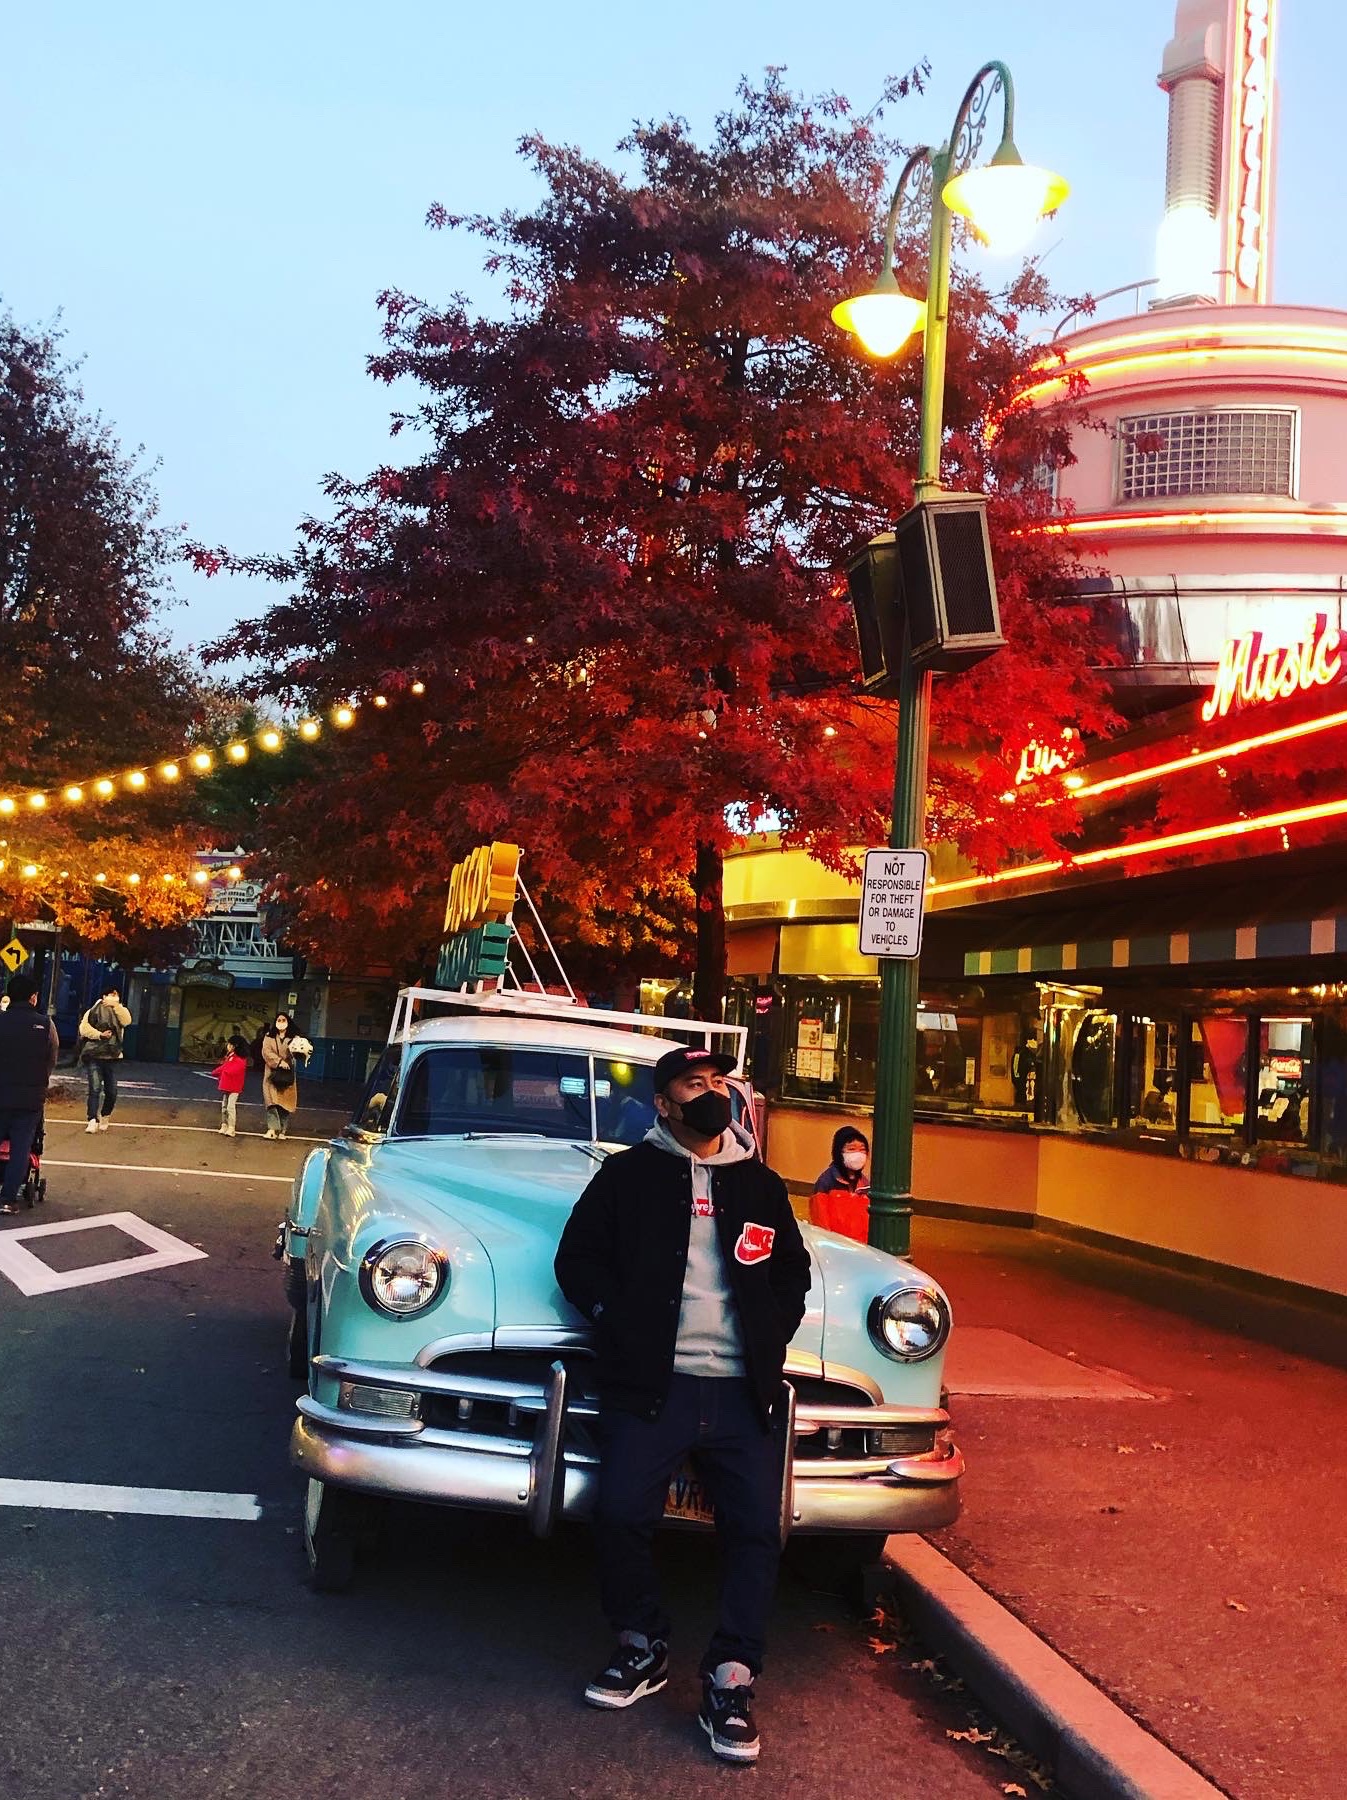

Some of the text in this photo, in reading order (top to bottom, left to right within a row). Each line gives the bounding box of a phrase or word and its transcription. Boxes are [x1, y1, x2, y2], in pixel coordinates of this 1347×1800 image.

[1202, 616, 1341, 721] Music
[884, 862, 906, 876] NOT
[867, 879, 921, 891] RESPONSIBLE
[870, 893, 914, 904] FOR THEFT
[868, 907, 915, 918] OR DAMAGE
[885, 921, 896, 932] TO
[871, 934, 908, 946] VEHICLES
[744, 1225, 774, 1249] NIKE
